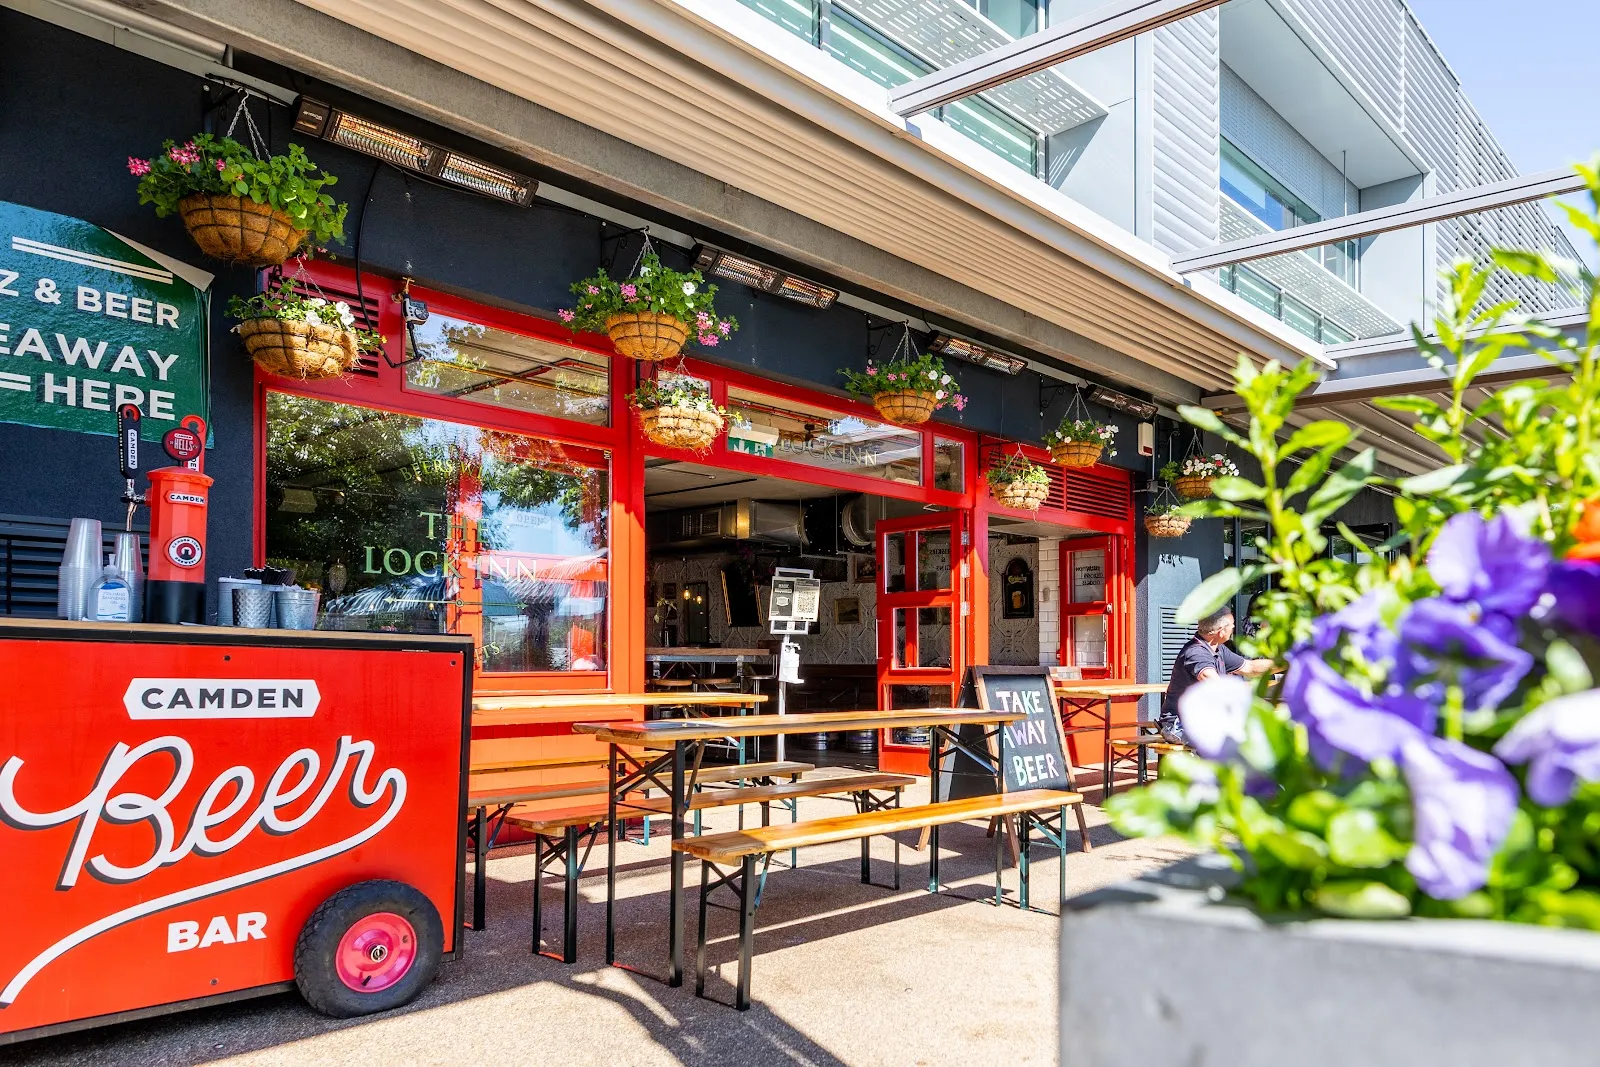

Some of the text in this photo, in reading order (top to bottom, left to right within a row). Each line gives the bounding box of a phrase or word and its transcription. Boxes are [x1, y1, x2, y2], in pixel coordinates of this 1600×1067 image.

[34, 278, 61, 305] &
[77, 285, 180, 329] BEER
[44, 372, 176, 421] HERE
[174, 438, 194, 452] HELLS
[841, 443, 877, 465] INN
[399, 459, 454, 482] BEERS
[170, 494, 205, 504] CAMDEN
[419, 511, 490, 543] THE
[363, 546, 537, 583] LOCK INN
[141, 687, 304, 710] CAMDEN
[996, 691, 1044, 714] TAKE
[1003, 720, 1047, 749] AWAY
[1013, 753, 1060, 787] BEER
[0, 735, 407, 892] Beer
[167, 911, 267, 953] BAR
